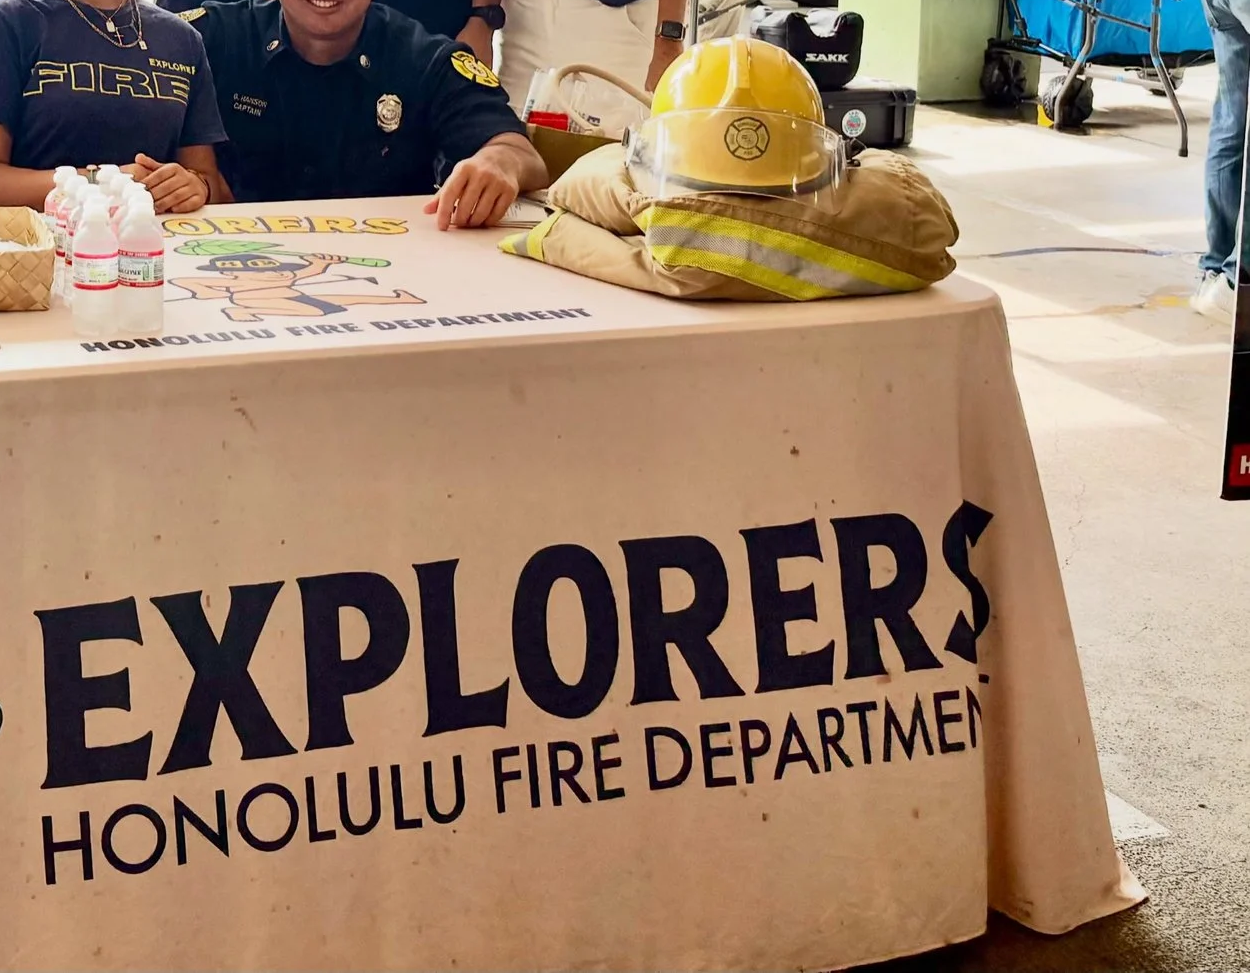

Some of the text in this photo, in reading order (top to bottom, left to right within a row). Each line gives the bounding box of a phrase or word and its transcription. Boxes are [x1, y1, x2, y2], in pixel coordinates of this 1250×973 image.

[23, 60, 191, 106] FIRE
[234, 102, 261, 116] CAPTAIN
[163, 216, 410, 236] ORERS
[81, 308, 592, 353] HONOLULU FIRE DEPARTMENT
[33, 499, 994, 789] EXPLORERS
[42, 754, 465, 885] HONOLULU
[493, 733, 625, 813] FIRE
